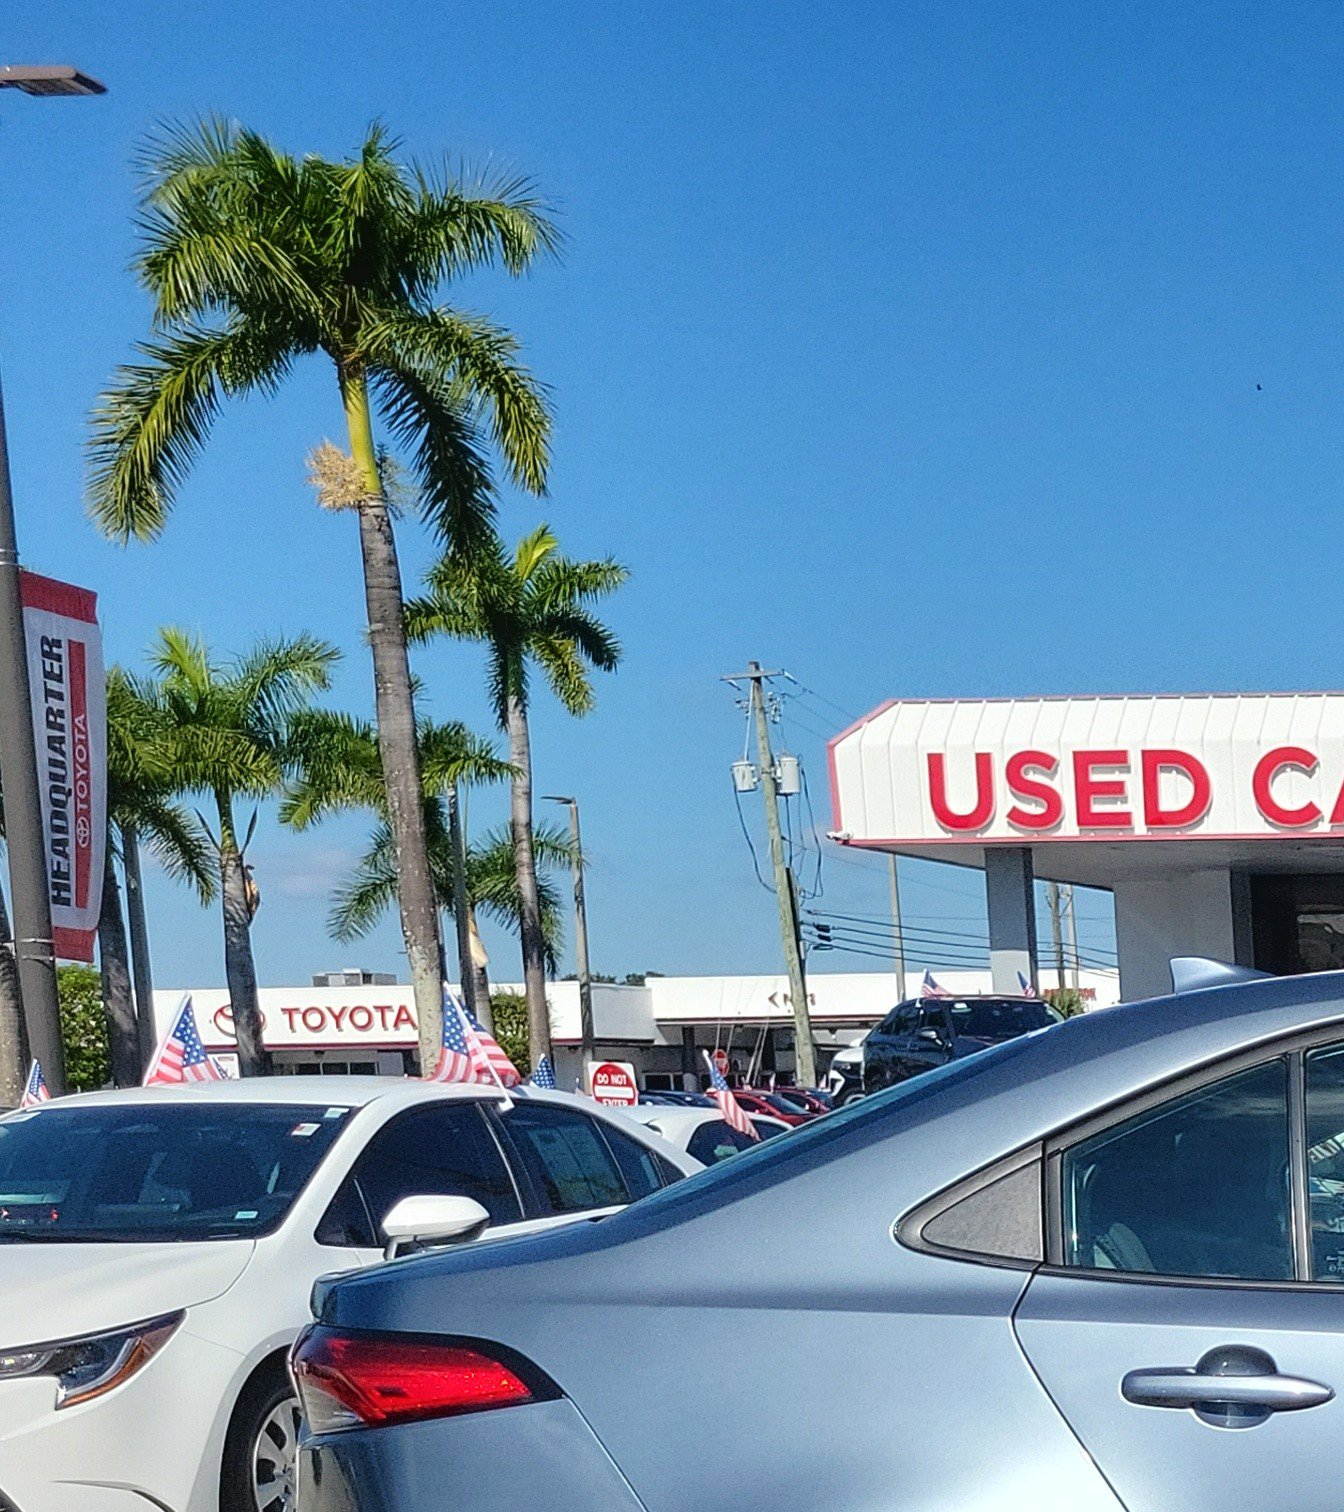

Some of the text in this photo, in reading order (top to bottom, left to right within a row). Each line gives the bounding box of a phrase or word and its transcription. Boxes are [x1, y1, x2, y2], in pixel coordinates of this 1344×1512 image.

[41, 634, 72, 907] HEADQUARTER
[74, 714, 91, 812] TOYOTA
[927, 749, 1212, 830] USED
[281, 1004, 418, 1033] TOYOTA
[597, 1073, 627, 1085] DO NOT
